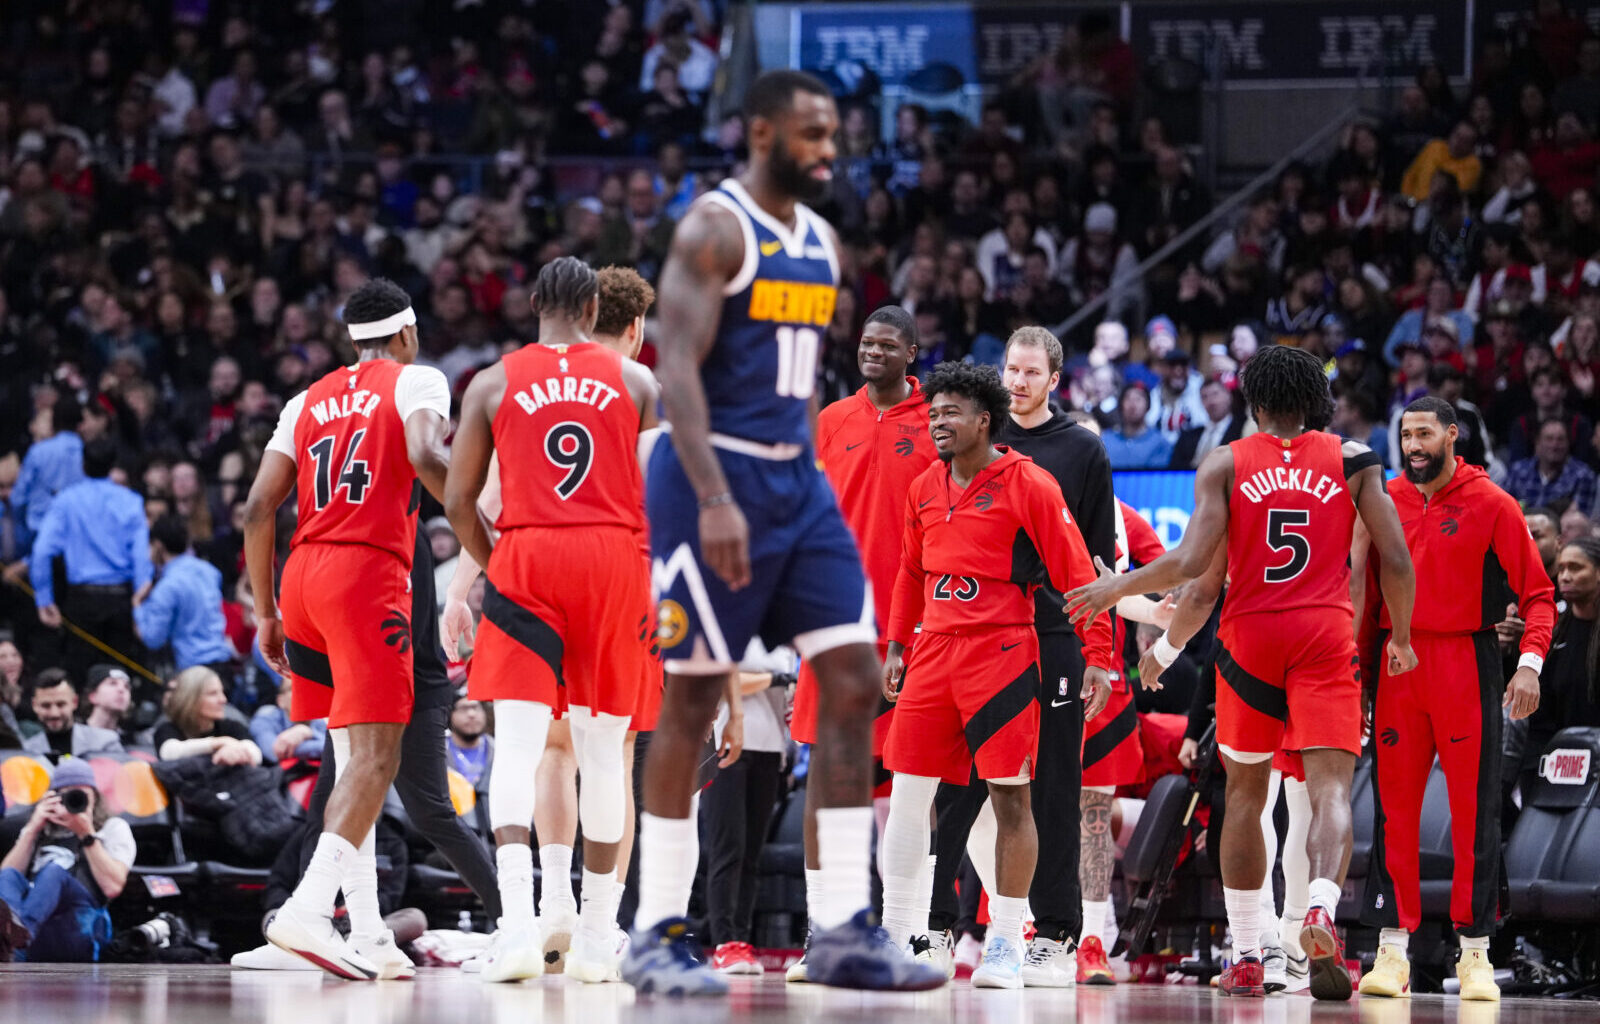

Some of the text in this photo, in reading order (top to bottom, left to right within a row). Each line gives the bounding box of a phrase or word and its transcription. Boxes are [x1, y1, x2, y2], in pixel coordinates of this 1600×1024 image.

[1319, 15, 1438, 68] IBM
[776, 326, 818, 399] 10
[514, 376, 620, 415] BARRETT
[307, 427, 372, 511] 14
[543, 420, 594, 501] 9
[1240, 466, 1343, 504] QUICKLEY
[1264, 508, 1311, 583] 5
[1554, 755, 1585, 778] PRIME
